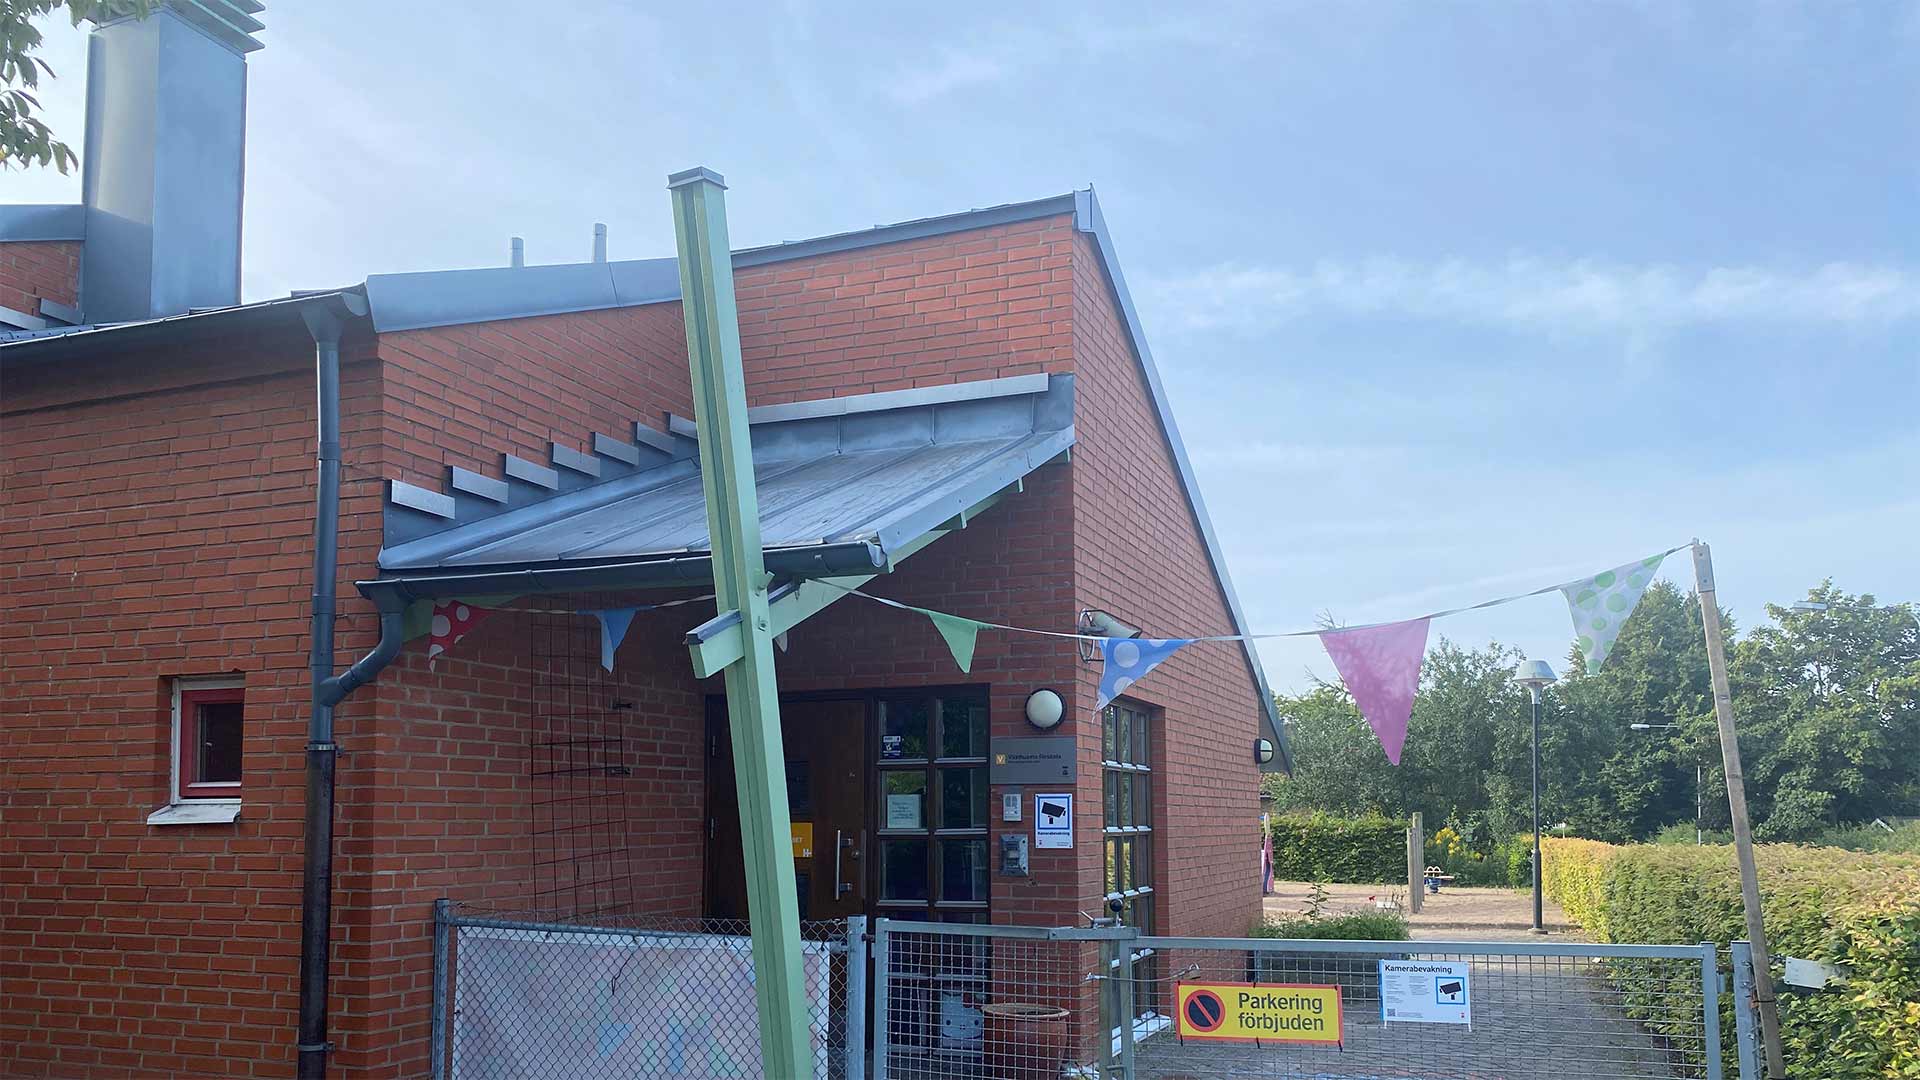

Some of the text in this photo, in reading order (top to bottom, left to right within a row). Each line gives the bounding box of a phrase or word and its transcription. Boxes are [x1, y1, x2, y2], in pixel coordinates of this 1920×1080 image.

[1384, 964, 1453, 974] Kamerabevakning
[1238, 992, 1323, 1014] Parkering
[1238, 1012, 1324, 1033] förbjuden
